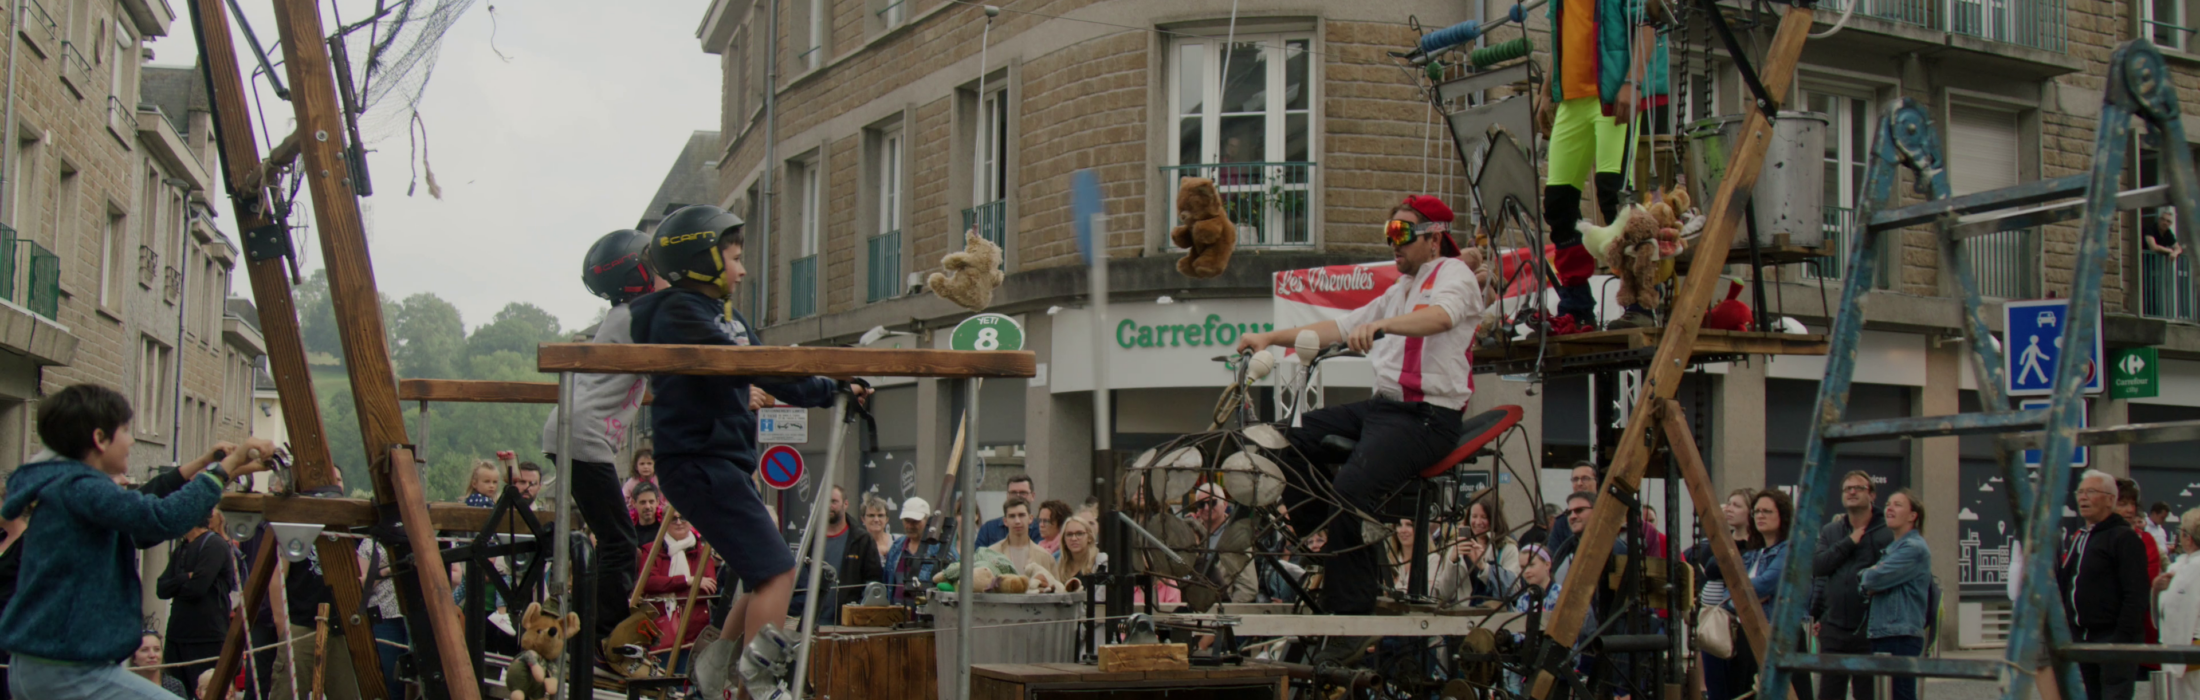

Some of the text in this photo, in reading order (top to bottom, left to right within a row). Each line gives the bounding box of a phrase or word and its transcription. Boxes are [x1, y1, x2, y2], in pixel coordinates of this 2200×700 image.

[1277, 266, 1375, 295] Les Virevoltés
[976, 316, 1000, 326] YETI
[974, 327, 1000, 350] 8
[2115, 377, 2149, 386] Carrefour
[1459, 482, 1475, 491] efour
